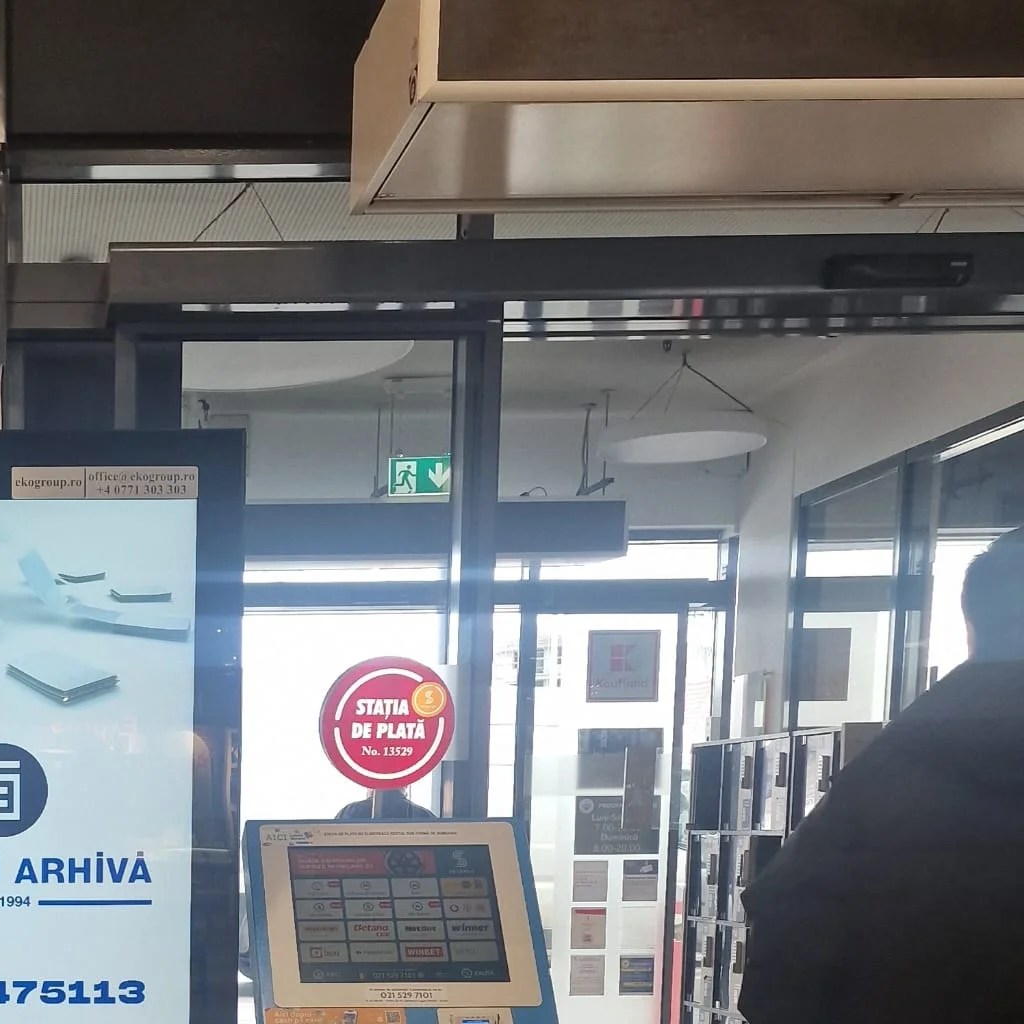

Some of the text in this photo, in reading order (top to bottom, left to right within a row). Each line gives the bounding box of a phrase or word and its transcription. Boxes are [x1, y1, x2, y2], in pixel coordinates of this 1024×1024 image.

[15, 477, 82, 489] ekogroup.ro
[96, 485, 186, 495] +4 0771 303 303
[355, 698, 410, 720] STAȚIA
[351, 719, 426, 740] DE PLATĂ
[361, 745, 413, 757] No. 13529
